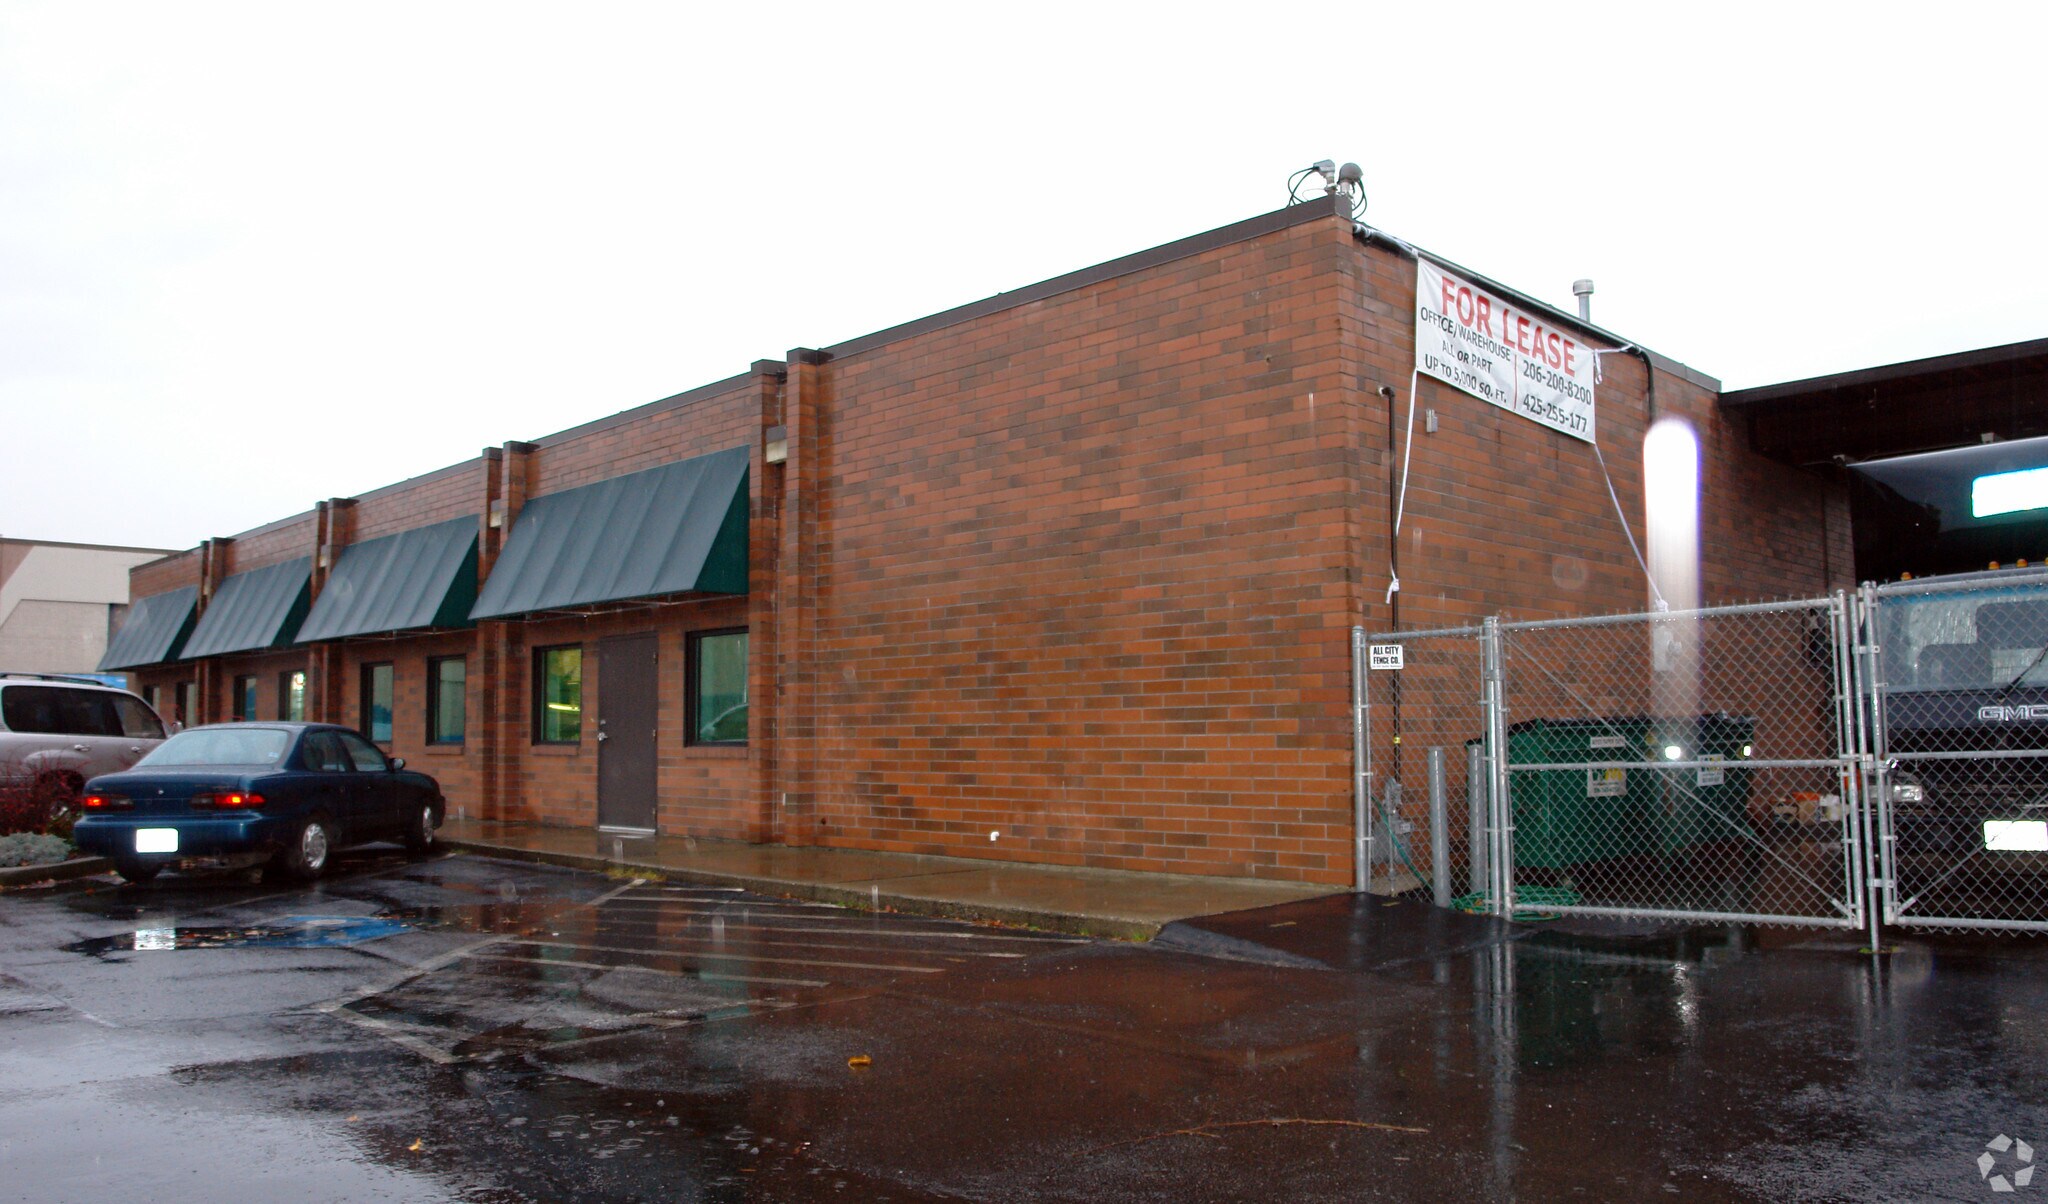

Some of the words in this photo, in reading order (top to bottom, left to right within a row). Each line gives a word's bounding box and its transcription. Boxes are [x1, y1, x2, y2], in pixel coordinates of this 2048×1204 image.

[1421, 307, 1511, 361] OFFICE/WAREHOUSE
[1442, 276, 1493, 339] FOR
[1503, 308, 1575, 378] LEASE
[1442, 340, 1455, 358] ALL
[1457, 350, 1469, 364] OR
[1472, 353, 1492, 374] PART
[1425, 353, 1438, 371] UP
[1441, 363, 1452, 377] TO
[1479, 382, 1493, 398] SQ.
[1495, 389, 1506, 403] FT.
[1523, 360, 1591, 405] 206-200-8200
[1523, 393, 1587, 432] 425-255-177
[1373, 646, 1383, 655] ALL
[1384, 646, 1399, 655] CITY
[1373, 656, 1389, 664] FENCE
[1978, 704, 2048, 721] GMC
